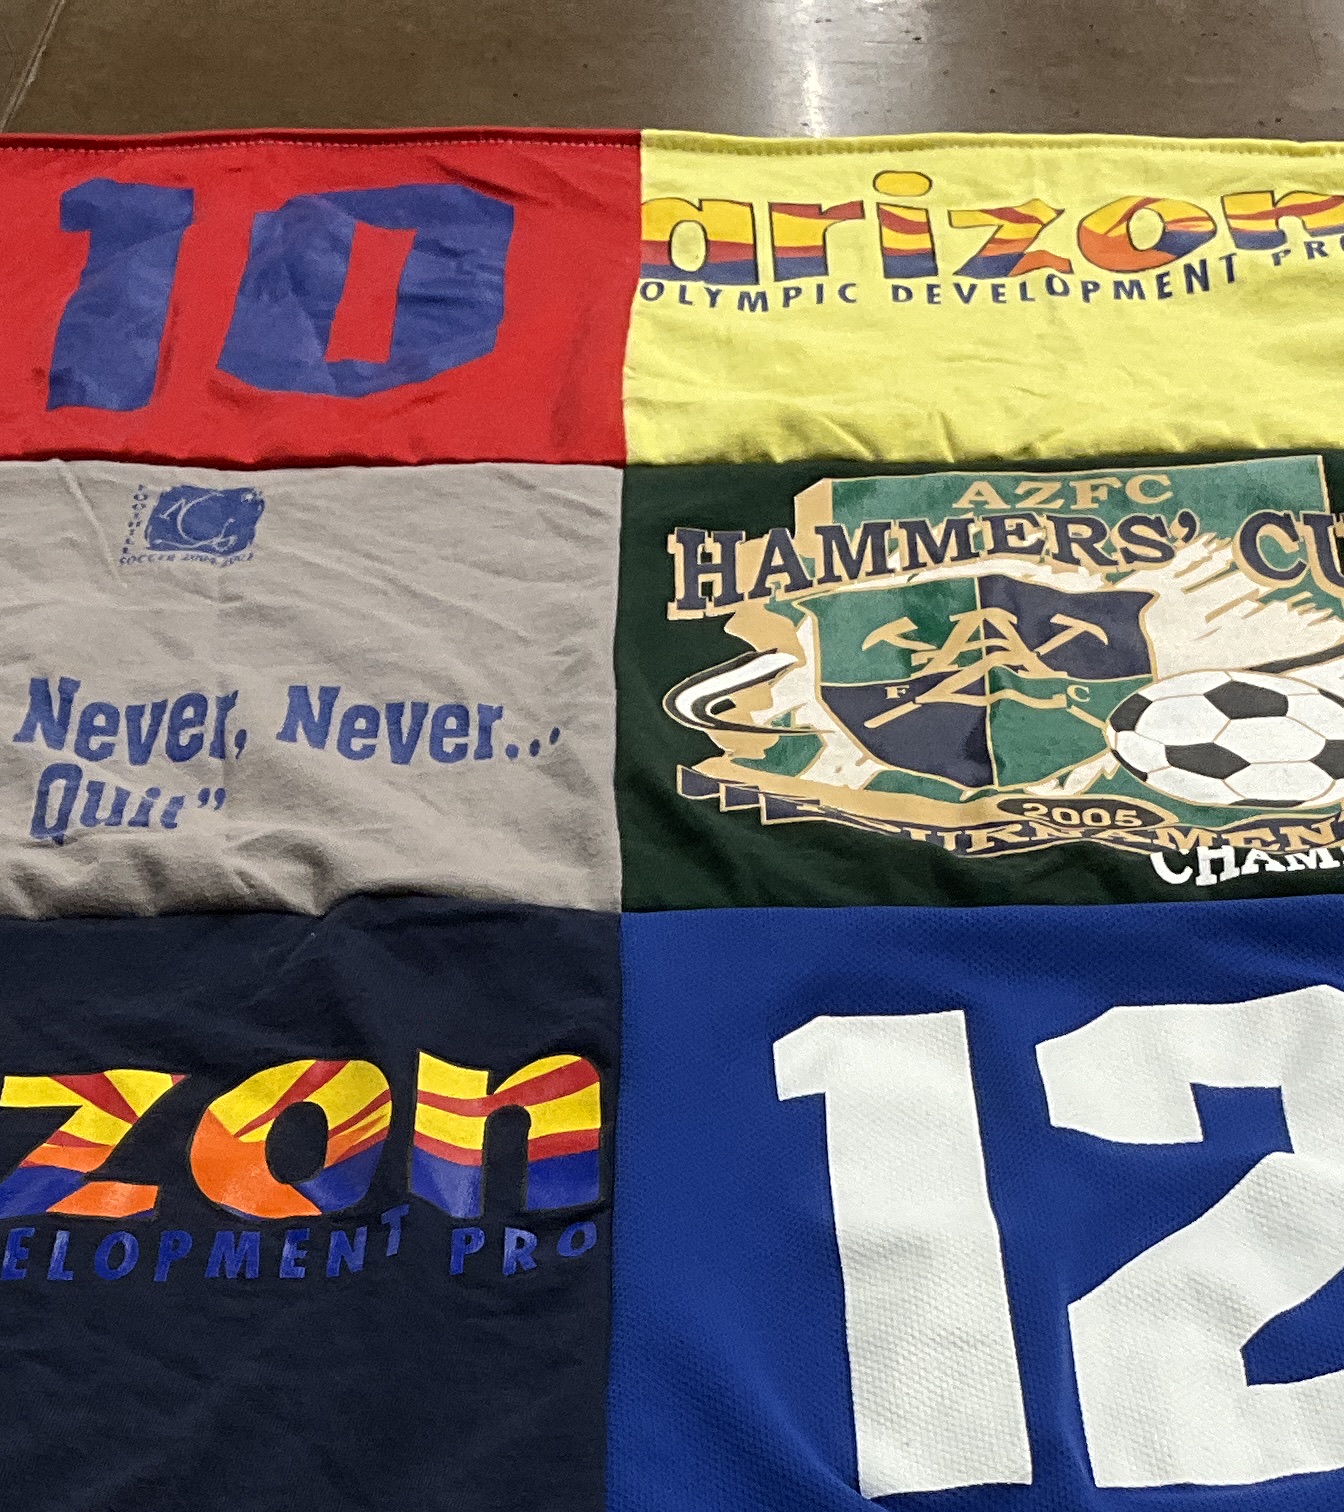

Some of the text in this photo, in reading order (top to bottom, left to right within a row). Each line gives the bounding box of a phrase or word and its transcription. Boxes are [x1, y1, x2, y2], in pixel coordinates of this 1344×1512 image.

[46, 178, 514, 412] 10
[639, 281, 857, 313] OLYMPIC
[891, 253, 1237, 305] DEVELOPMENT
[952, 473, 1172, 511] AZFC
[12, 675, 247, 762] Never,
[276, 684, 561, 765] Never...
[1023, 801, 1144, 829] 2005
[448, 1221, 599, 1278] PRO
